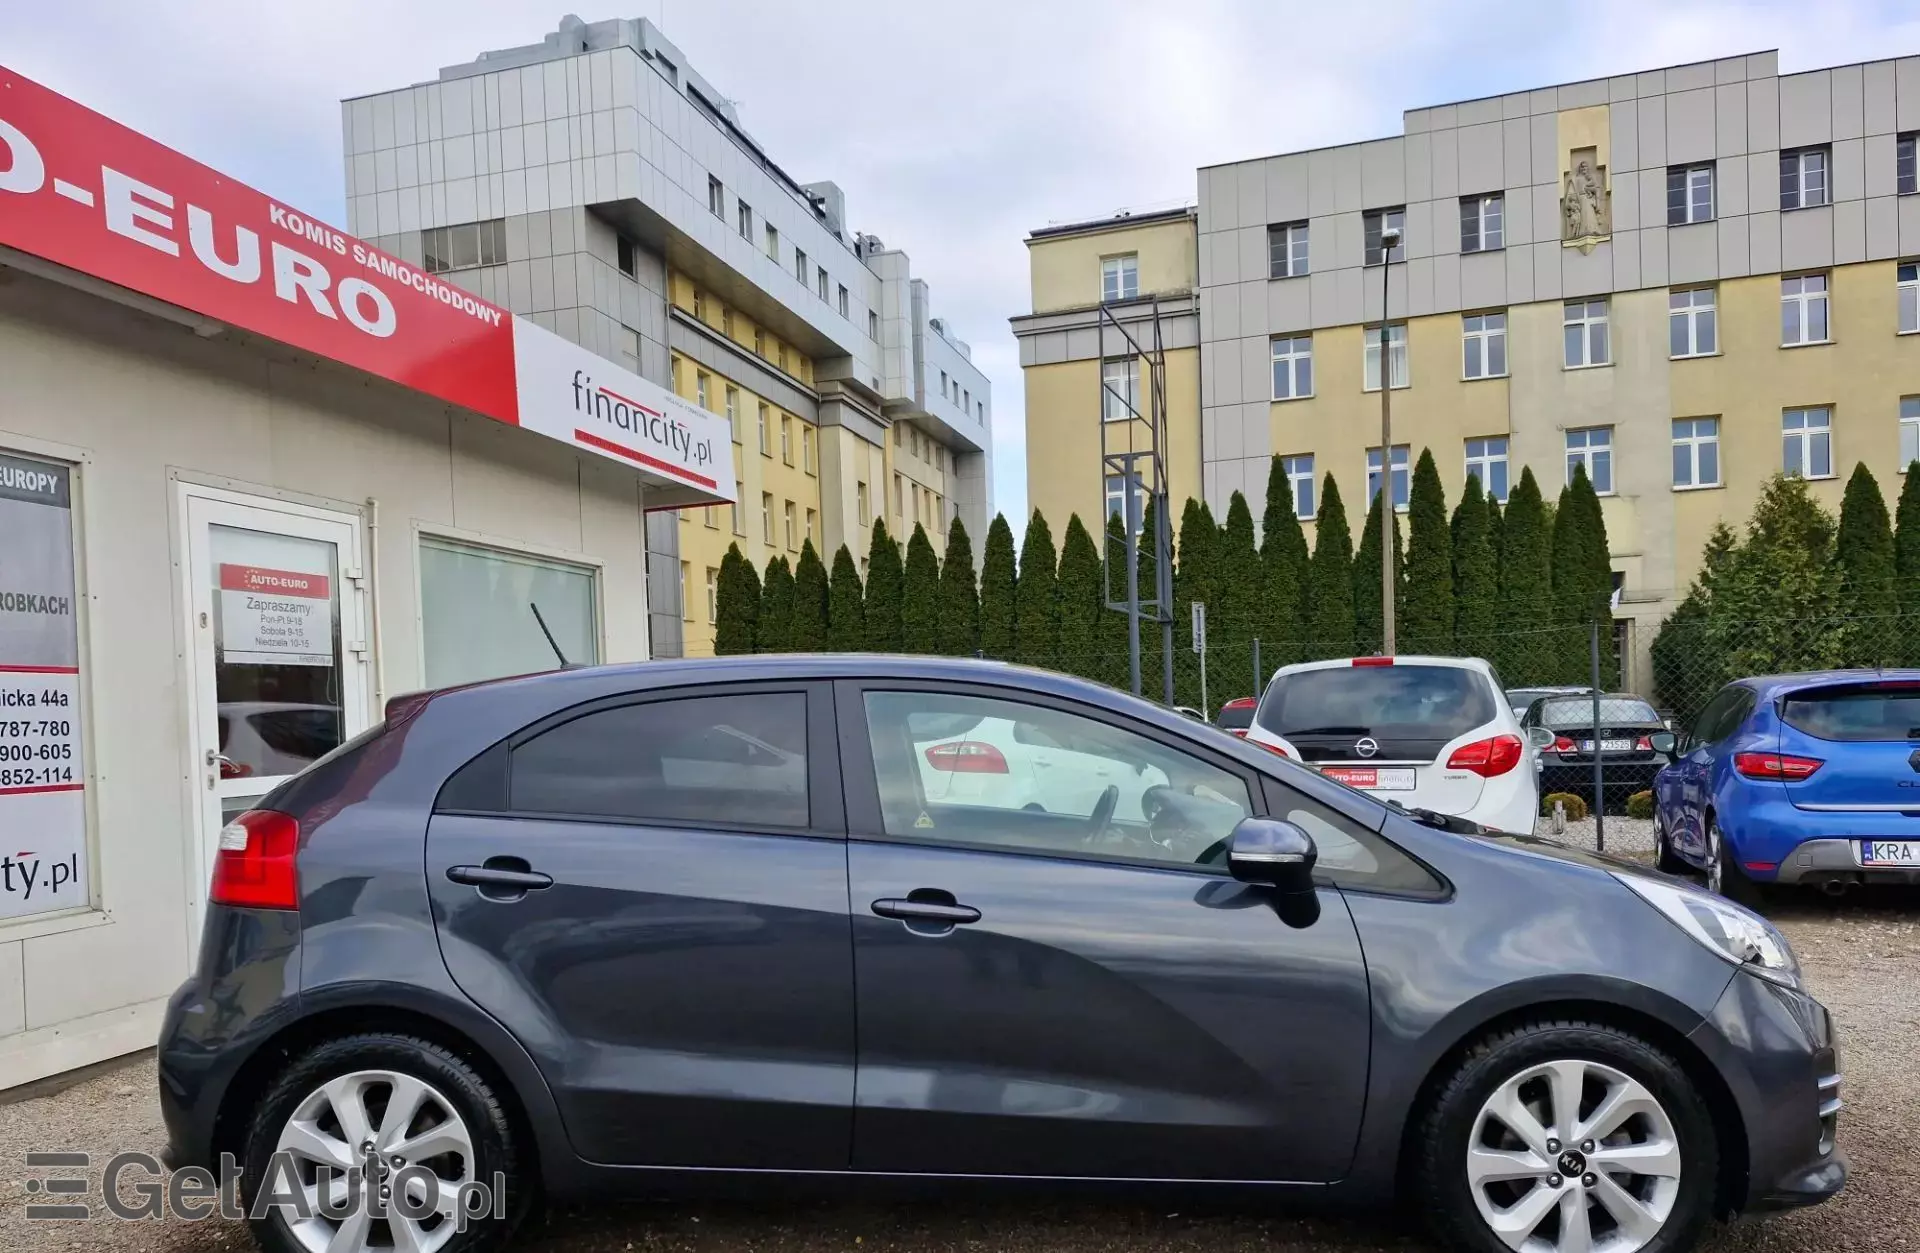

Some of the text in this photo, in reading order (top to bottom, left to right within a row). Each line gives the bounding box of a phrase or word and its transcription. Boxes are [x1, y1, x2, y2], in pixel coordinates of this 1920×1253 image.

[269, 203, 501, 328] KOMIS SAMOCHODOWY
[572, 370, 712, 467] financity.pl
[0, 466, 58, 494] UROPY
[250, 574, 309, 590] AUTO-EURO
[260, 614, 286, 625] Pon-Pt
[260, 625, 286, 636] Sobota
[255, 637, 288, 648] Niedziela
[0, 688, 69, 707] icka 44a
[0, 766, 72, 786] 852-114
[1874, 843, 1912, 860] KRA
